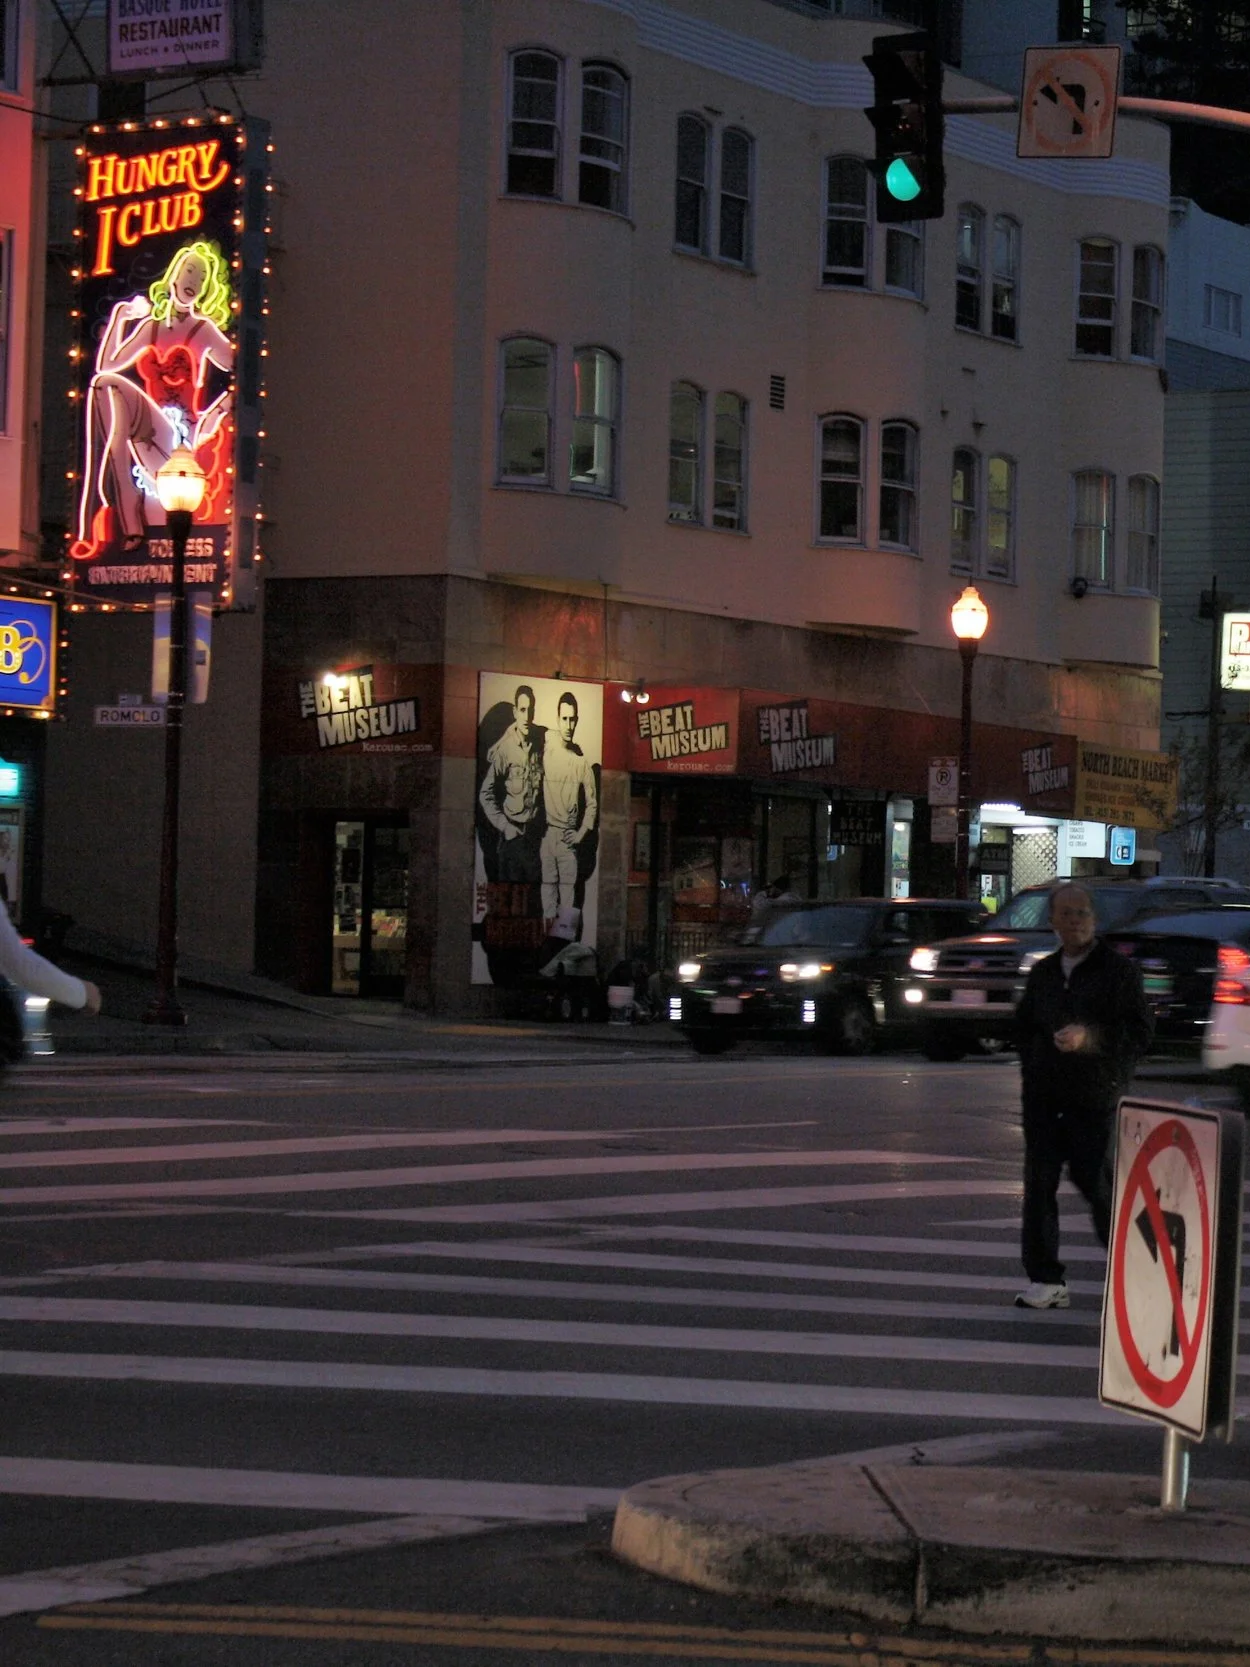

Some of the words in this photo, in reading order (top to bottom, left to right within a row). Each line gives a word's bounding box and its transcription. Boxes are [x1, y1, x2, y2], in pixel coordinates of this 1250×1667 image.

[119, 14, 222, 42] RESTAURANT
[120, 46, 158, 58] LUNCH
[173, 40, 219, 53] DINNER
[86, 140, 230, 202] HUNGRY
[92, 206, 117, 276] I
[117, 193, 202, 246] CLUB
[148, 538, 213, 557] TOESS
[88, 564, 217, 584] ENTERTAINENT
[299, 680, 315, 719] THE
[314, 674, 372, 715] BEAT
[100, 710, 160, 722] ROMOLO
[317, 700, 416, 748] MUSEUM
[638, 712, 650, 738] THE
[650, 705, 693, 736] BEAT
[759, 709, 770, 744] THE
[768, 708, 808, 742] BEAT
[361, 742, 433, 752] Kerouac.com
[652, 725, 727, 760] MUSEUM
[771, 737, 835, 773] MUSEUM
[1028, 747, 1052, 772] BEAT
[1081, 752, 1110, 774] NORTH
[1112, 756, 1139, 779] BEACH
[1028, 766, 1069, 795] MUSEUM
[476, 882, 487, 914] THE
